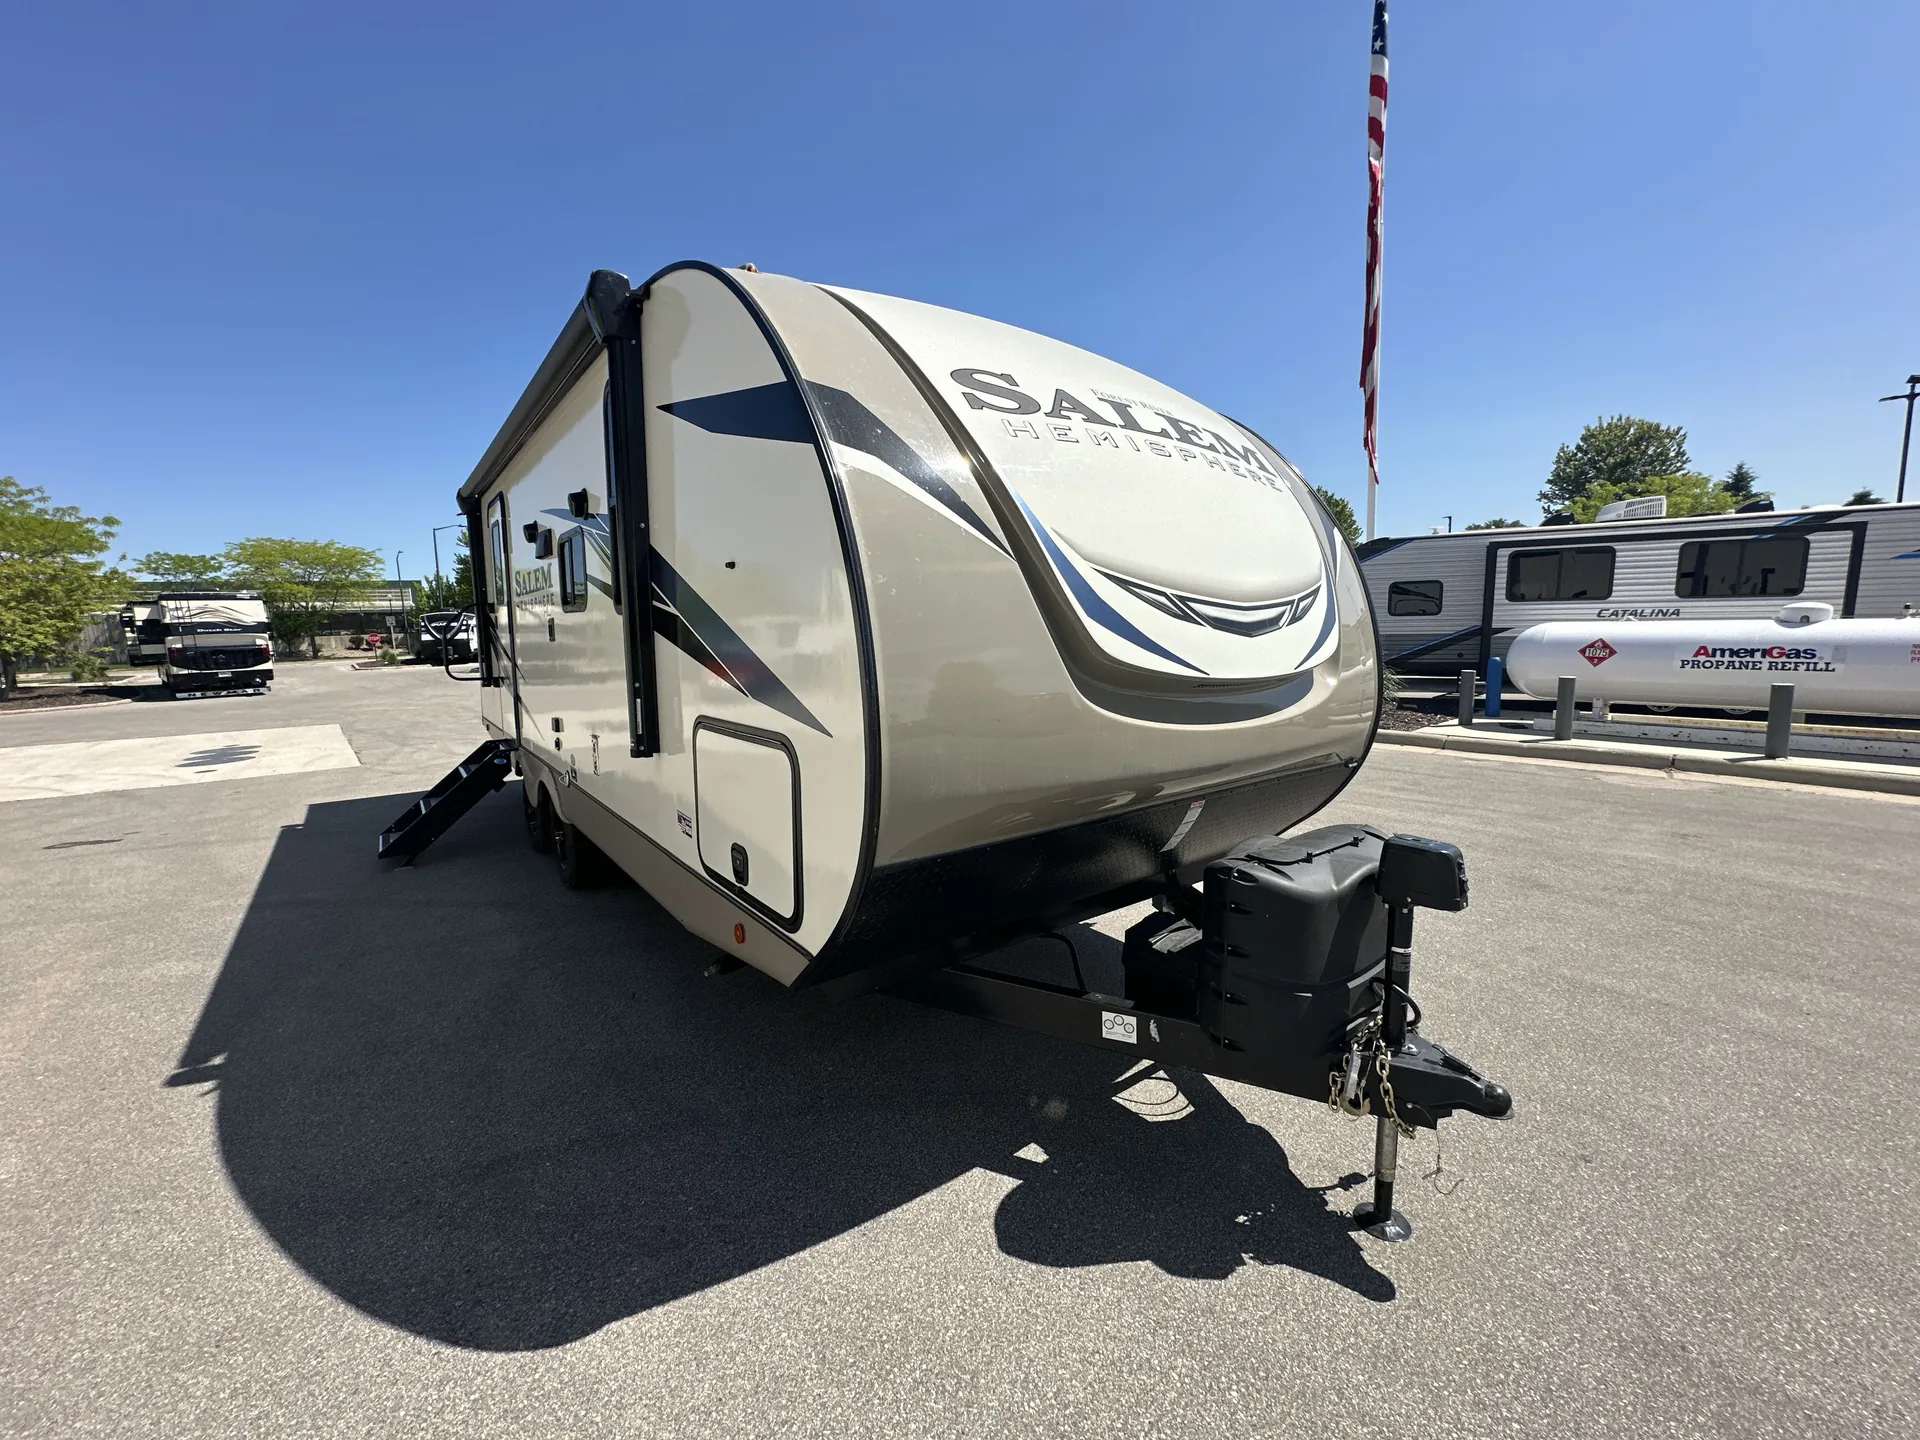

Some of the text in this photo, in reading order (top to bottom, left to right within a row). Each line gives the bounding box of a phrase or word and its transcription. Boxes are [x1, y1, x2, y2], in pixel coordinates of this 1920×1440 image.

[950, 367, 1278, 479] SALEM
[1000, 418, 1283, 493] HEMISPHERE
[515, 562, 553, 597] SALEM
[1596, 608, 1681, 618] CATALINA
[1587, 648, 1608, 657] 1075
[1692, 645, 1818, 660] AmeriGas
[1679, 659, 1836, 673] PROPANE REFILL
